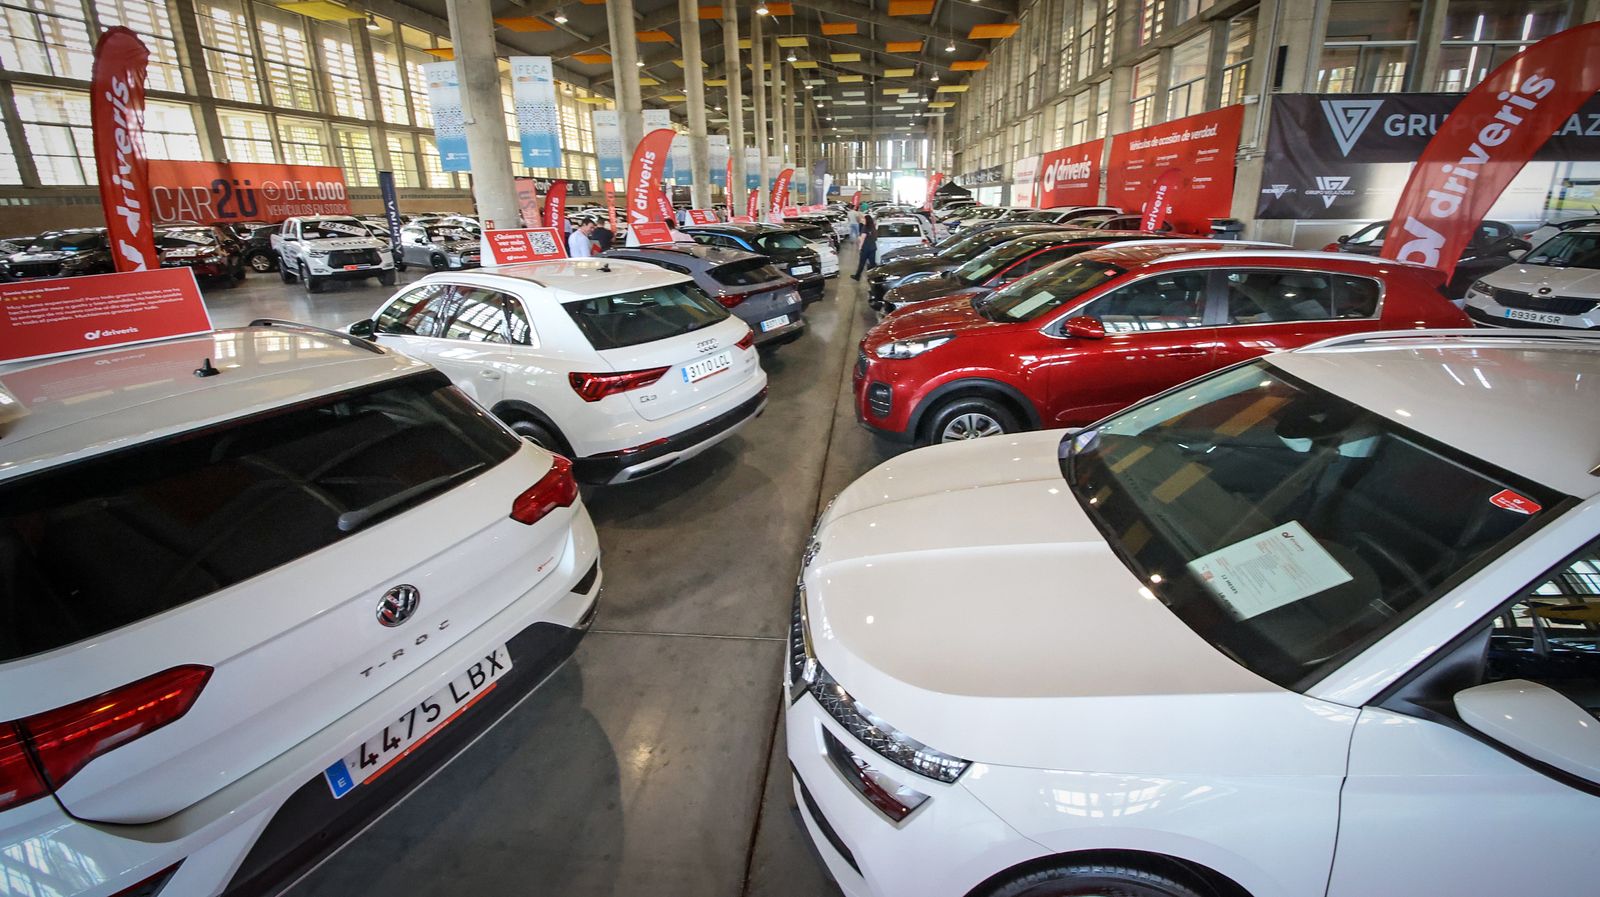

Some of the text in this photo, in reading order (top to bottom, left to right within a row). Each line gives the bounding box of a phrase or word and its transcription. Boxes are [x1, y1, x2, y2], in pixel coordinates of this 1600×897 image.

[514, 64, 548, 75] IFECA
[1158, 132, 1181, 146] ocasión
[1181, 129, 1191, 141] de
[1427, 72, 1556, 219] driveris
[105, 76, 141, 237] driveris
[1056, 154, 1092, 181] driveris
[284, 181, 345, 201] DE 1.000
[635, 151, 656, 210] driveris
[267, 202, 350, 216] VEHÍCULOS EN STOCK
[1146, 185, 1168, 231] driveris
[1510, 310, 1561, 324] 6939 KSR
[101, 326, 139, 337] driveris
[688, 360, 713, 378] 3110
[716, 354, 730, 369] LCL
[360, 619, 449, 678] T-ROC
[359, 650, 505, 770] 4475 LBX
